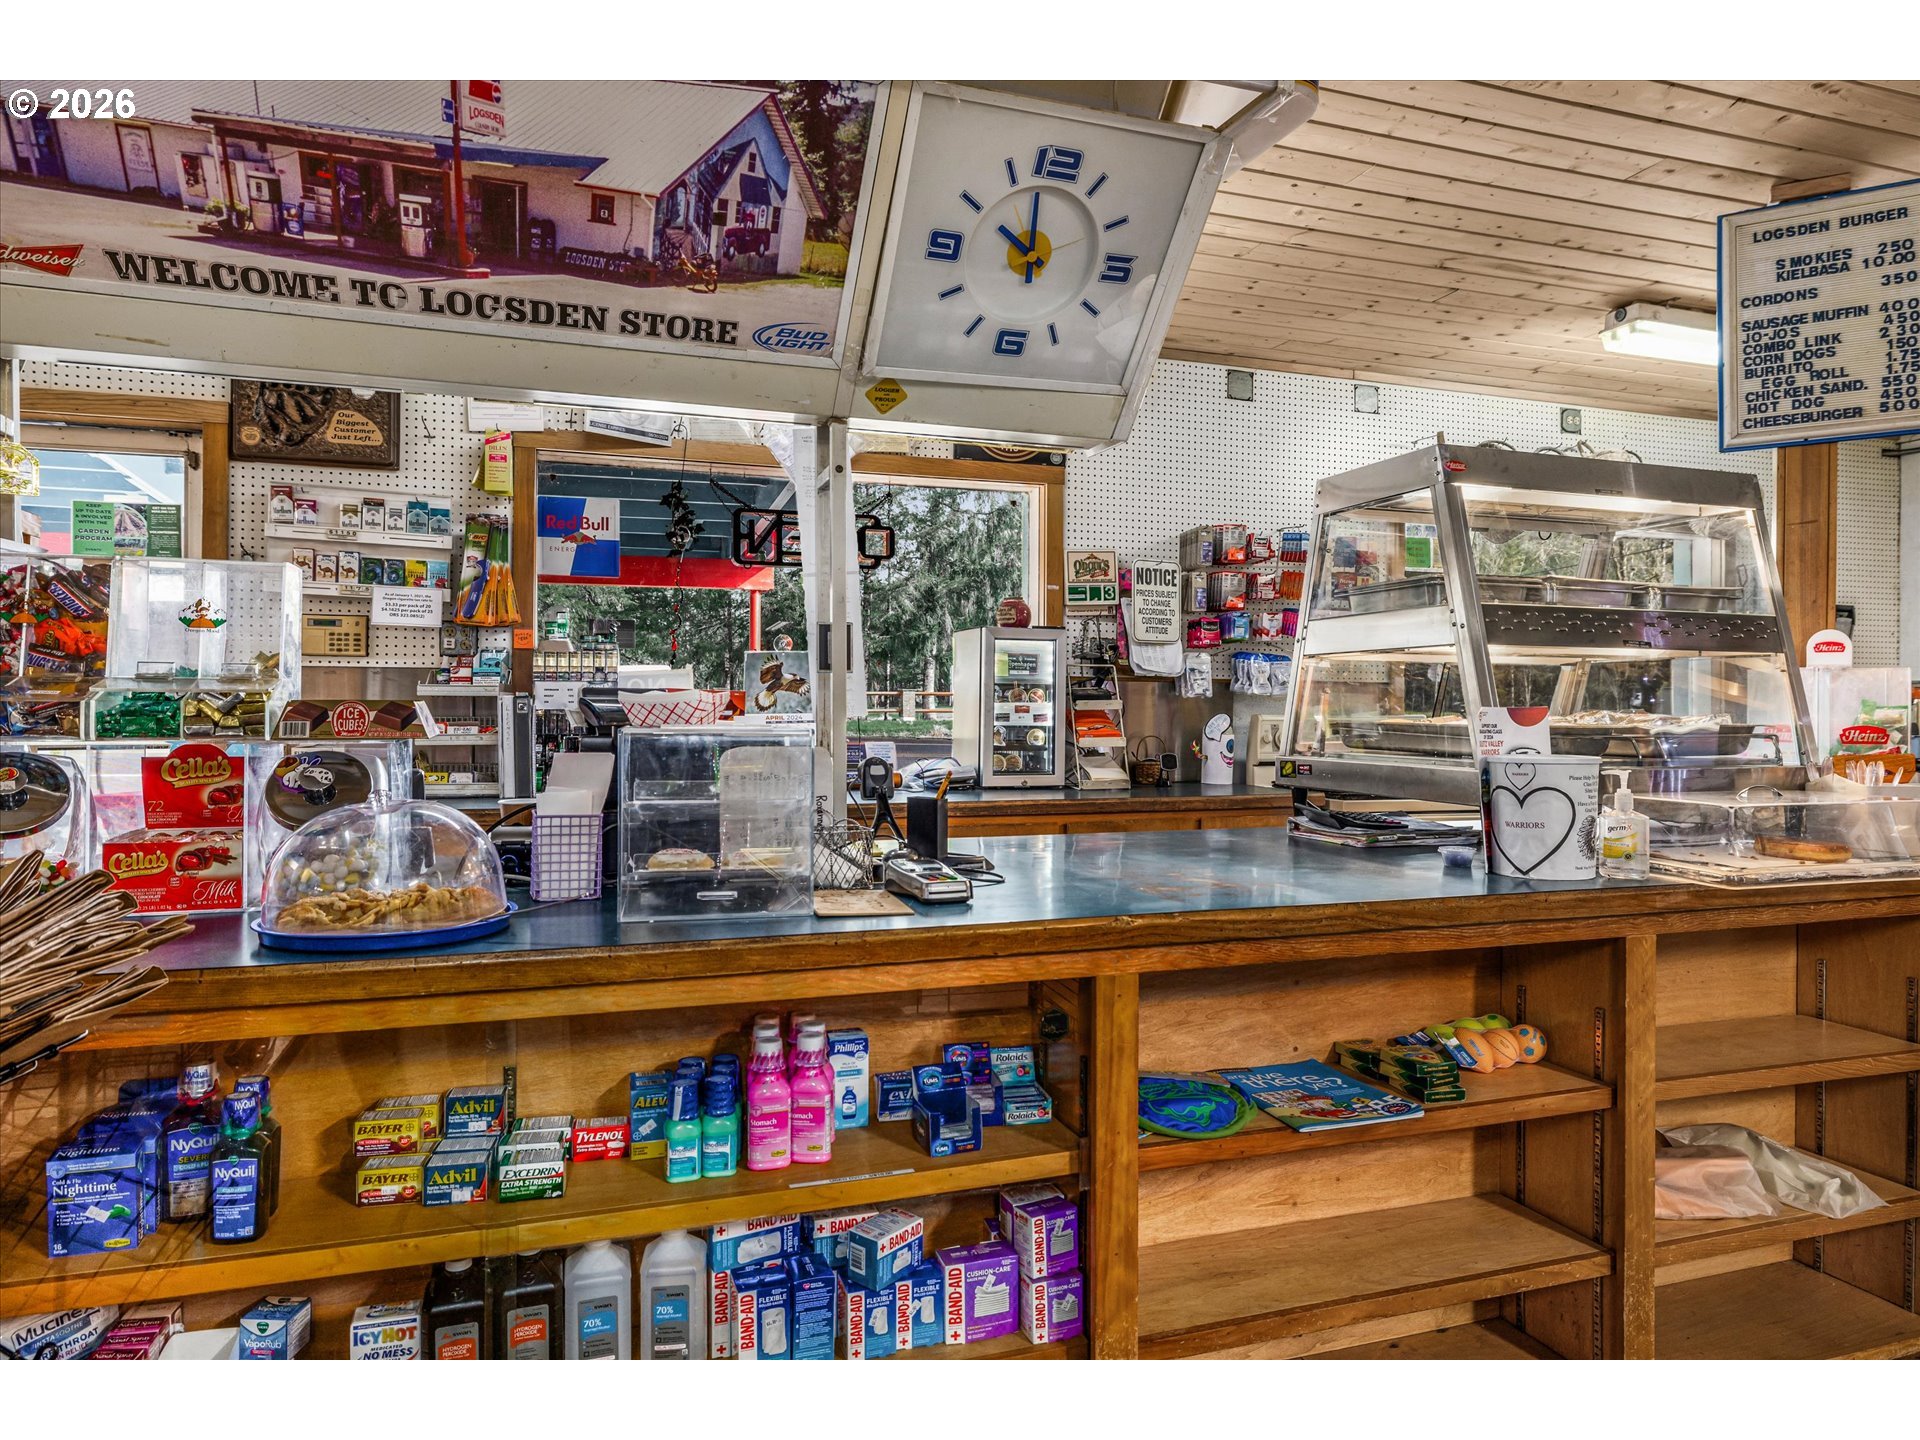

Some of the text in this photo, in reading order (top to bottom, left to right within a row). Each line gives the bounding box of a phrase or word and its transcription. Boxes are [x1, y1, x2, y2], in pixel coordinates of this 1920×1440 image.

[469, 106, 505, 127] LOGSDEN
[1031, 145, 1085, 184] 12
[1753, 207, 1908, 243] LOGSDEN BURGER
[925, 228, 965, 263] 9
[1878, 238, 1914, 254] 250
[0, 245, 86, 267] dweiser
[566, 251, 606, 268] LOGSDEN
[1098, 252, 1139, 284] 3
[1776, 250, 1916, 282] KIELBASA 10.00
[1741, 270, 1918, 309] CORDONS 350
[104, 249, 740, 346] WELCOME TO LOGSDEN STORE
[1742, 297, 1919, 332] SAUSAGE MUFFIN 400
[775, 327, 829, 341] BUD
[1742, 311, 1920, 344] JO-JOS 450
[764, 336, 830, 351] LIGHT
[991, 328, 1030, 357] 6
[1743, 323, 1920, 356] COMBO LINK 230
[1743, 336, 1917, 368] CORN DOGS 150
[1744, 349, 1920, 379] BURRITO 1.75
[1761, 361, 1920, 389] EGG ROLL 1.75
[1745, 374, 1916, 403] CHICKEN SAND. 550
[1747, 386, 1917, 415] HOT DOG 450
[1743, 399, 1919, 429] CHEESEBURGER 500
[336, 419, 369, 428] Biggest
[331, 433, 349, 441] Just
[546, 514, 609, 531] Red Bull
[1136, 567, 1177, 587] NOTICE
[1136, 589, 1177, 599] PRICES SUBJECT
[1138, 608, 1167, 616] ACCORDING
[1142, 617, 1172, 626] CUSTOMERS
[1145, 627, 1168, 635] ATTITUDE
[1815, 642, 1844, 652] Heinz
[343, 708, 360, 719] ICE
[337, 719, 364, 731] CUBES
[1842, 730, 1888, 743] Heinz
[160, 755, 232, 783] Cella's
[147, 801, 164, 812] 72
[1505, 820, 1545, 829] WARRIORS
[1607, 824, 1632, 833] germ-X
[108, 850, 169, 874] Cella's
[192, 880, 236, 901] Milk
[996, 1052, 1028, 1062] Rolaids
[184, 1070, 209, 1081] NyQuil
[1228, 1070, 1283, 1081] are we
[1243, 1074, 1321, 1090] there
[1305, 1077, 1348, 1091] yet?
[234, 1098, 256, 1110] NyQuil
[450, 1099, 496, 1115] Advil
[634, 1096, 668, 1108] ALEV
[1007, 1112, 1037, 1120] Rolaids
[357, 1123, 403, 1136] BAYER
[170, 1134, 220, 1154] NyQuil
[576, 1130, 625, 1144] TYLENOL
[56, 1147, 120, 1158] Nighttime
[214, 1165, 255, 1181] NyQuil
[362, 1174, 409, 1186] BAYER
[428, 1168, 477, 1186] Advil
[503, 1166, 561, 1180] EXCEDRIN
[52, 1182, 117, 1198] Nighttime
[501, 1177, 562, 1189] EXTRA STRENGTH
[913, 1284, 940, 1294] FLEXIBLE
[758, 1293, 787, 1304] FLEXIBLE
[866, 1294, 894, 1305] FLEXIBLE
[656, 1306, 674, 1315] 70%
[514, 1324, 543, 1334] HYDROGEN
[583, 1318, 602, 1328] 70%
[58, 1326, 100, 1352] THROAT
[514, 1330, 538, 1338] PEROXIDE
[244, 1338, 282, 1350] VapoRub
[442, 1343, 472, 1353] HYDROGEN
[363, 1346, 414, 1360] NO MESS
[442, 1349, 467, 1358] PEROXIDE
